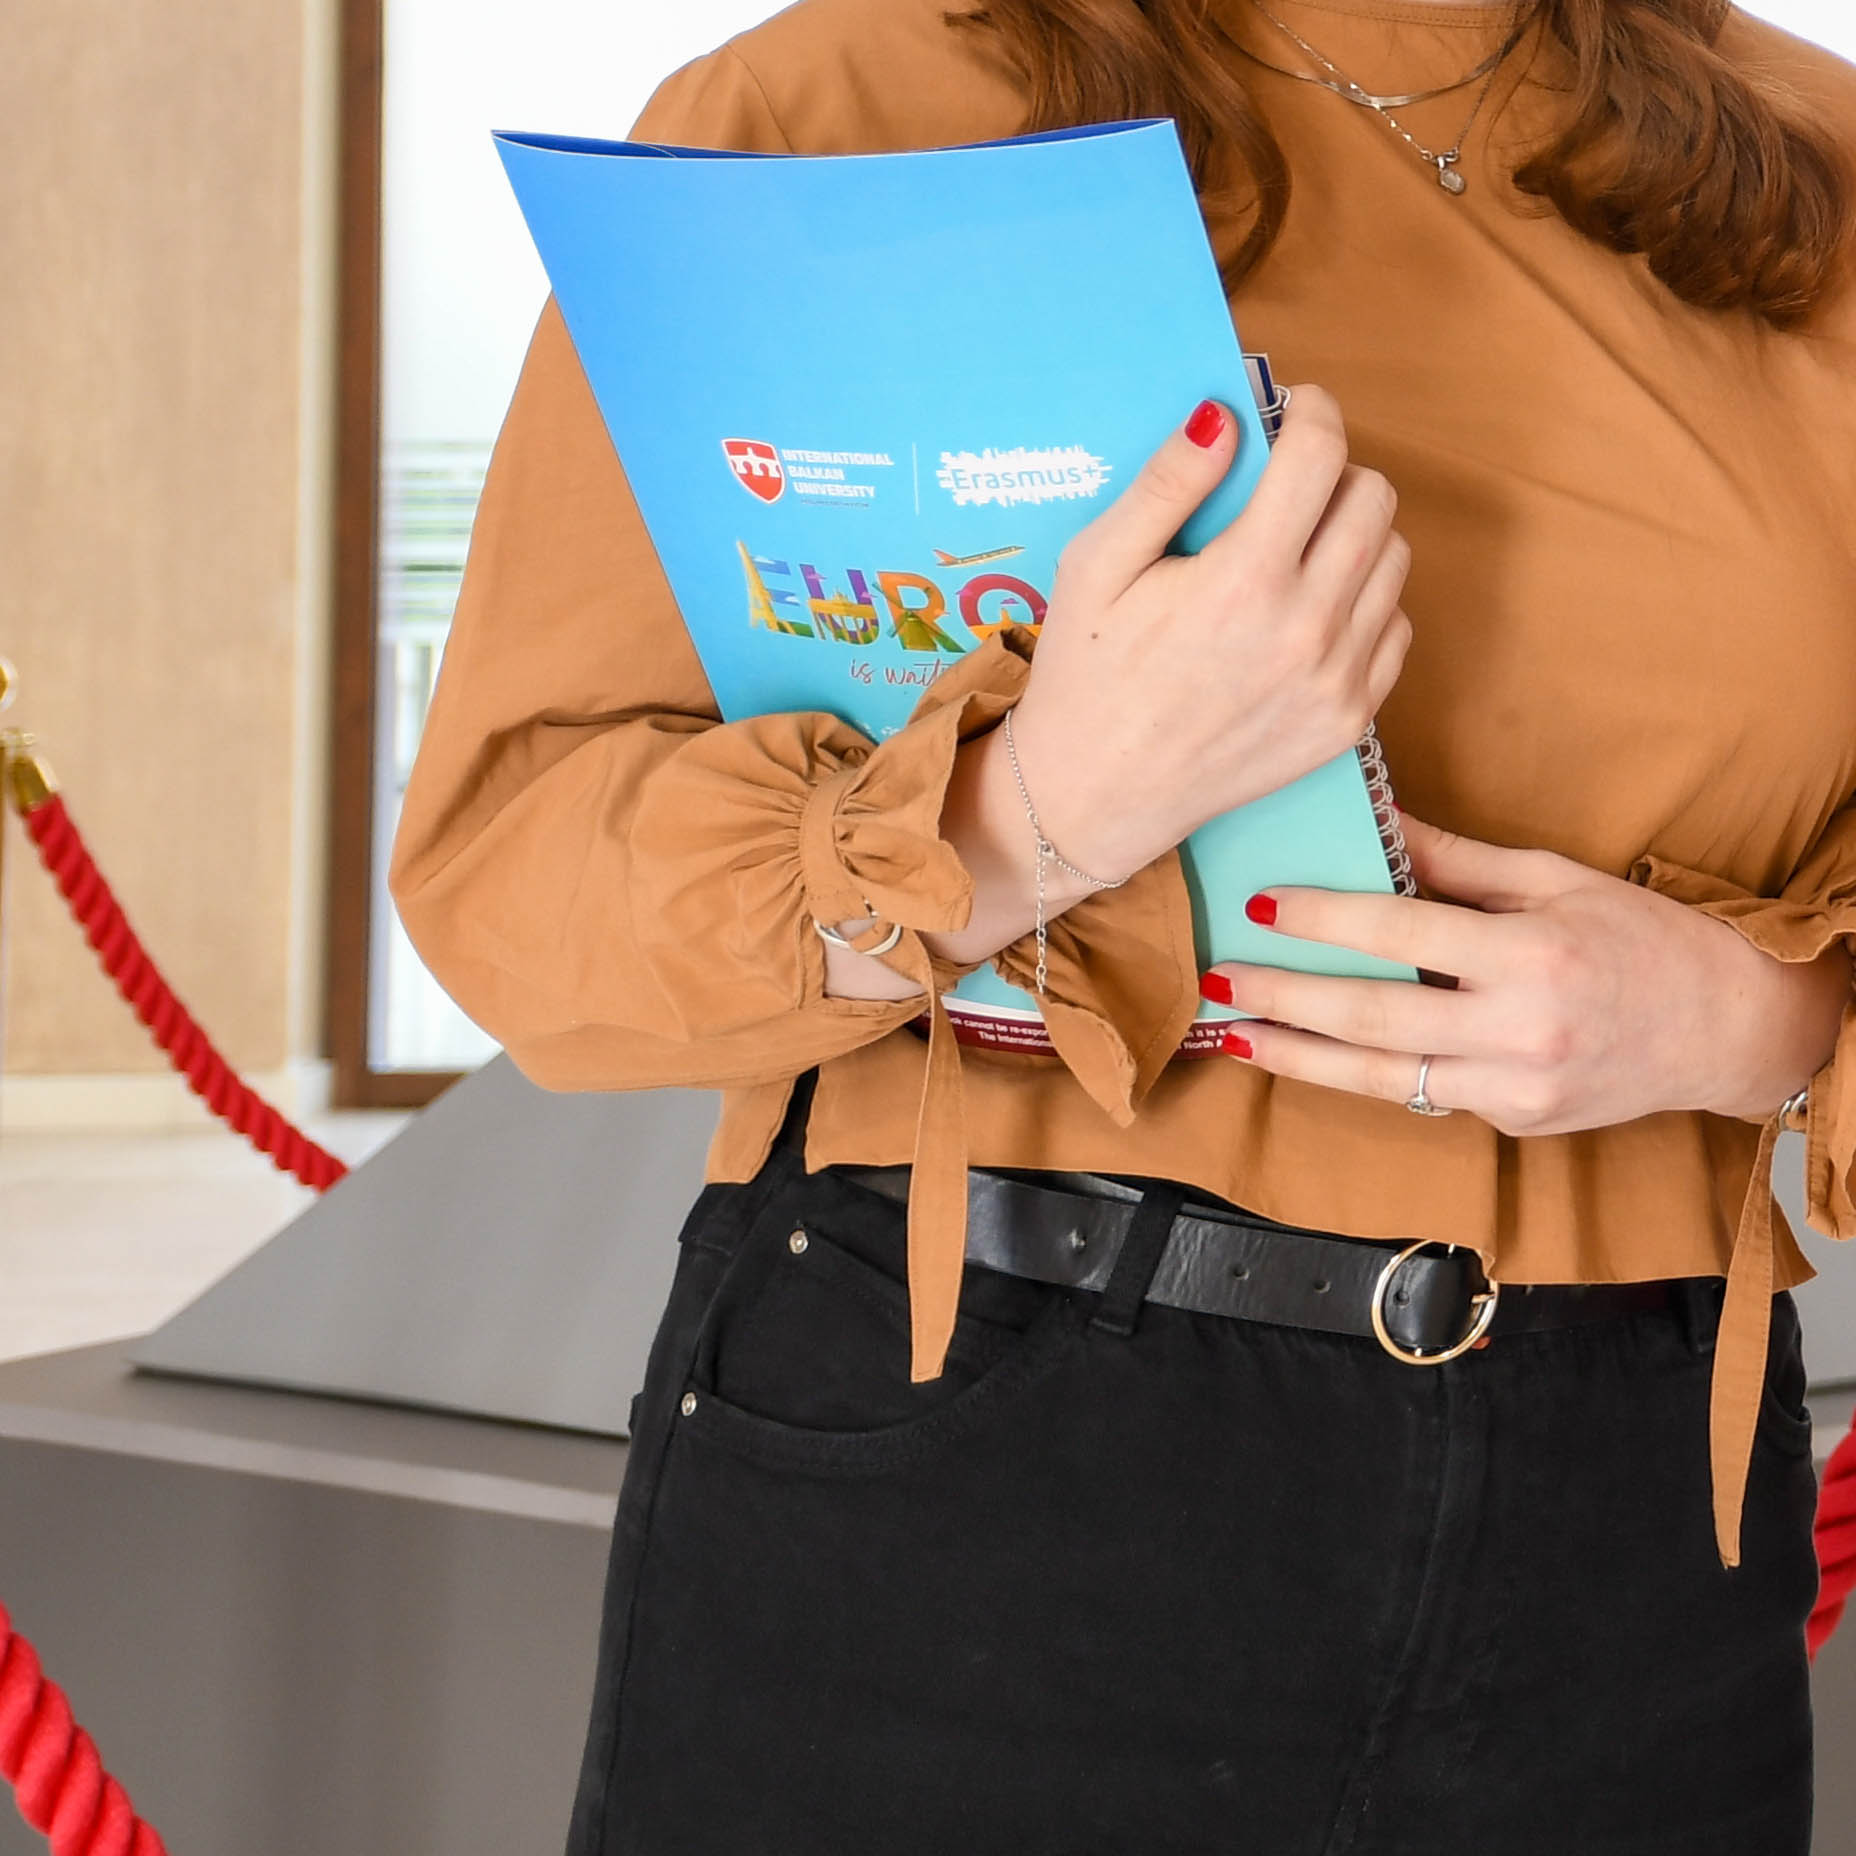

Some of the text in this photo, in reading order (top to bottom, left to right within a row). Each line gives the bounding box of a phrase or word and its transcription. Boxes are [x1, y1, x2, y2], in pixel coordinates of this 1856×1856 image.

[781, 449, 895, 466] INTERNATIONAL
[787, 465, 845, 480] BALKAN
[951, 463, 1100, 492] Erasmus+
[793, 481, 875, 497] UNIVERSITY
